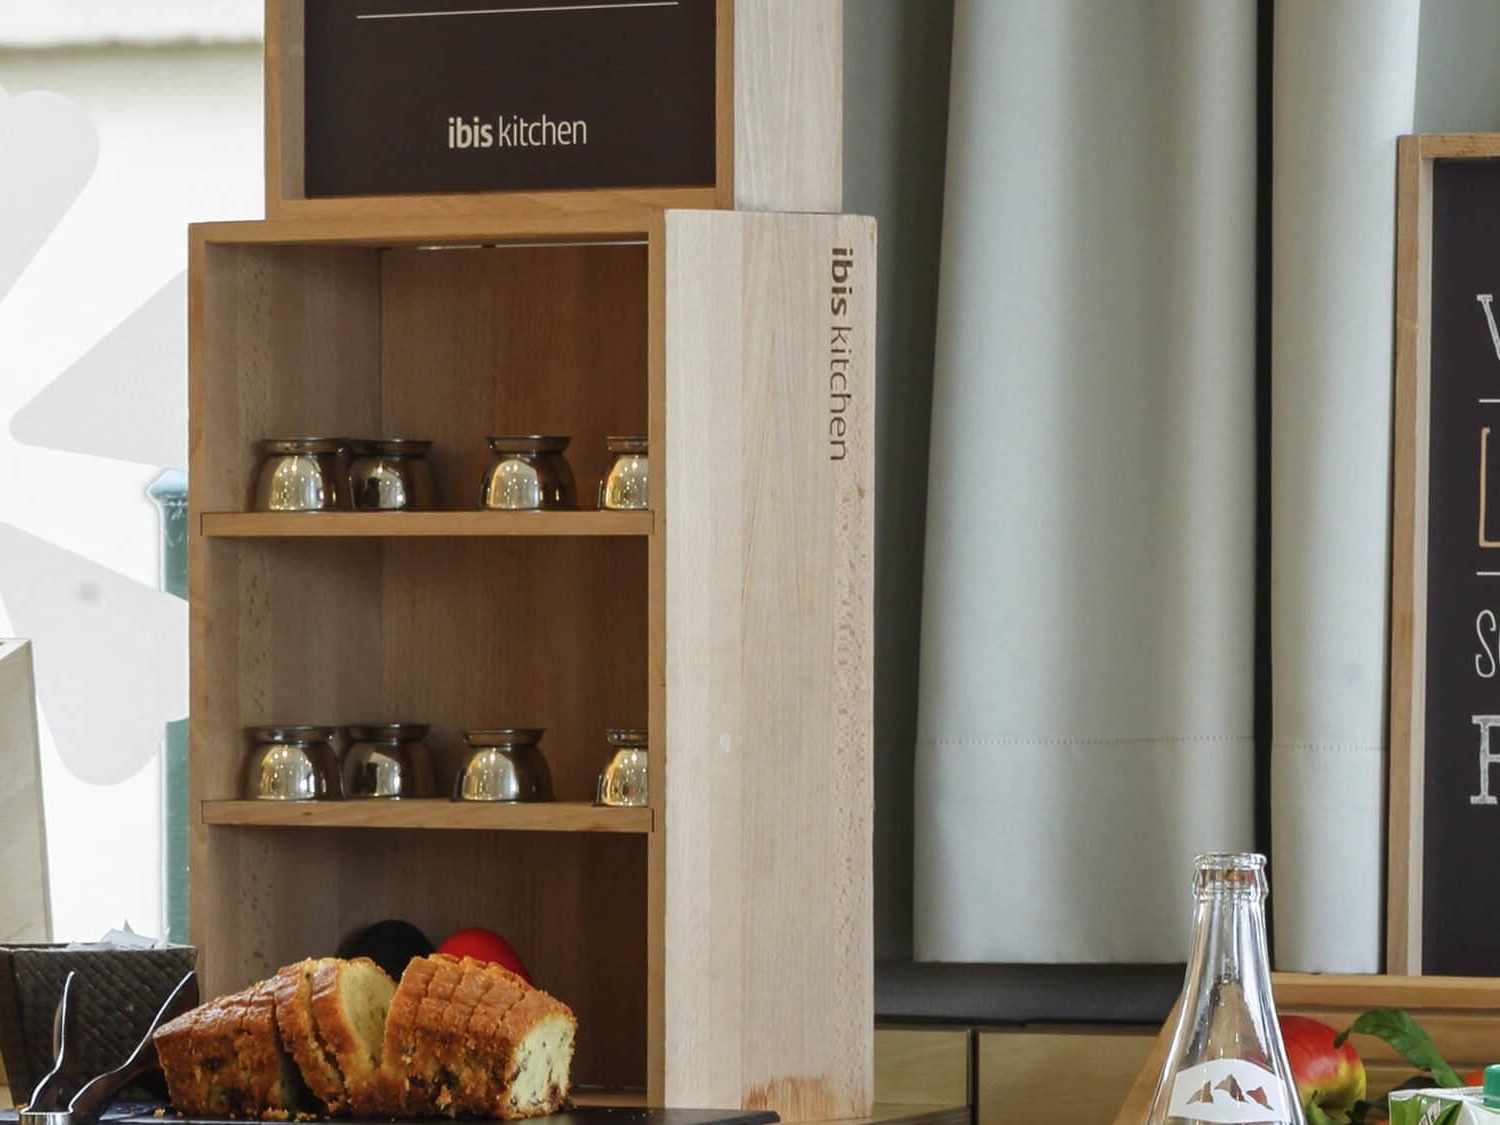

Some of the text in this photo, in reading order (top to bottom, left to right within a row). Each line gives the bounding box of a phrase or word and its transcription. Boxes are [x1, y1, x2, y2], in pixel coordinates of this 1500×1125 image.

[448, 114, 587, 149] ibis kitchen
[830, 248, 853, 460] ibis kitchen
